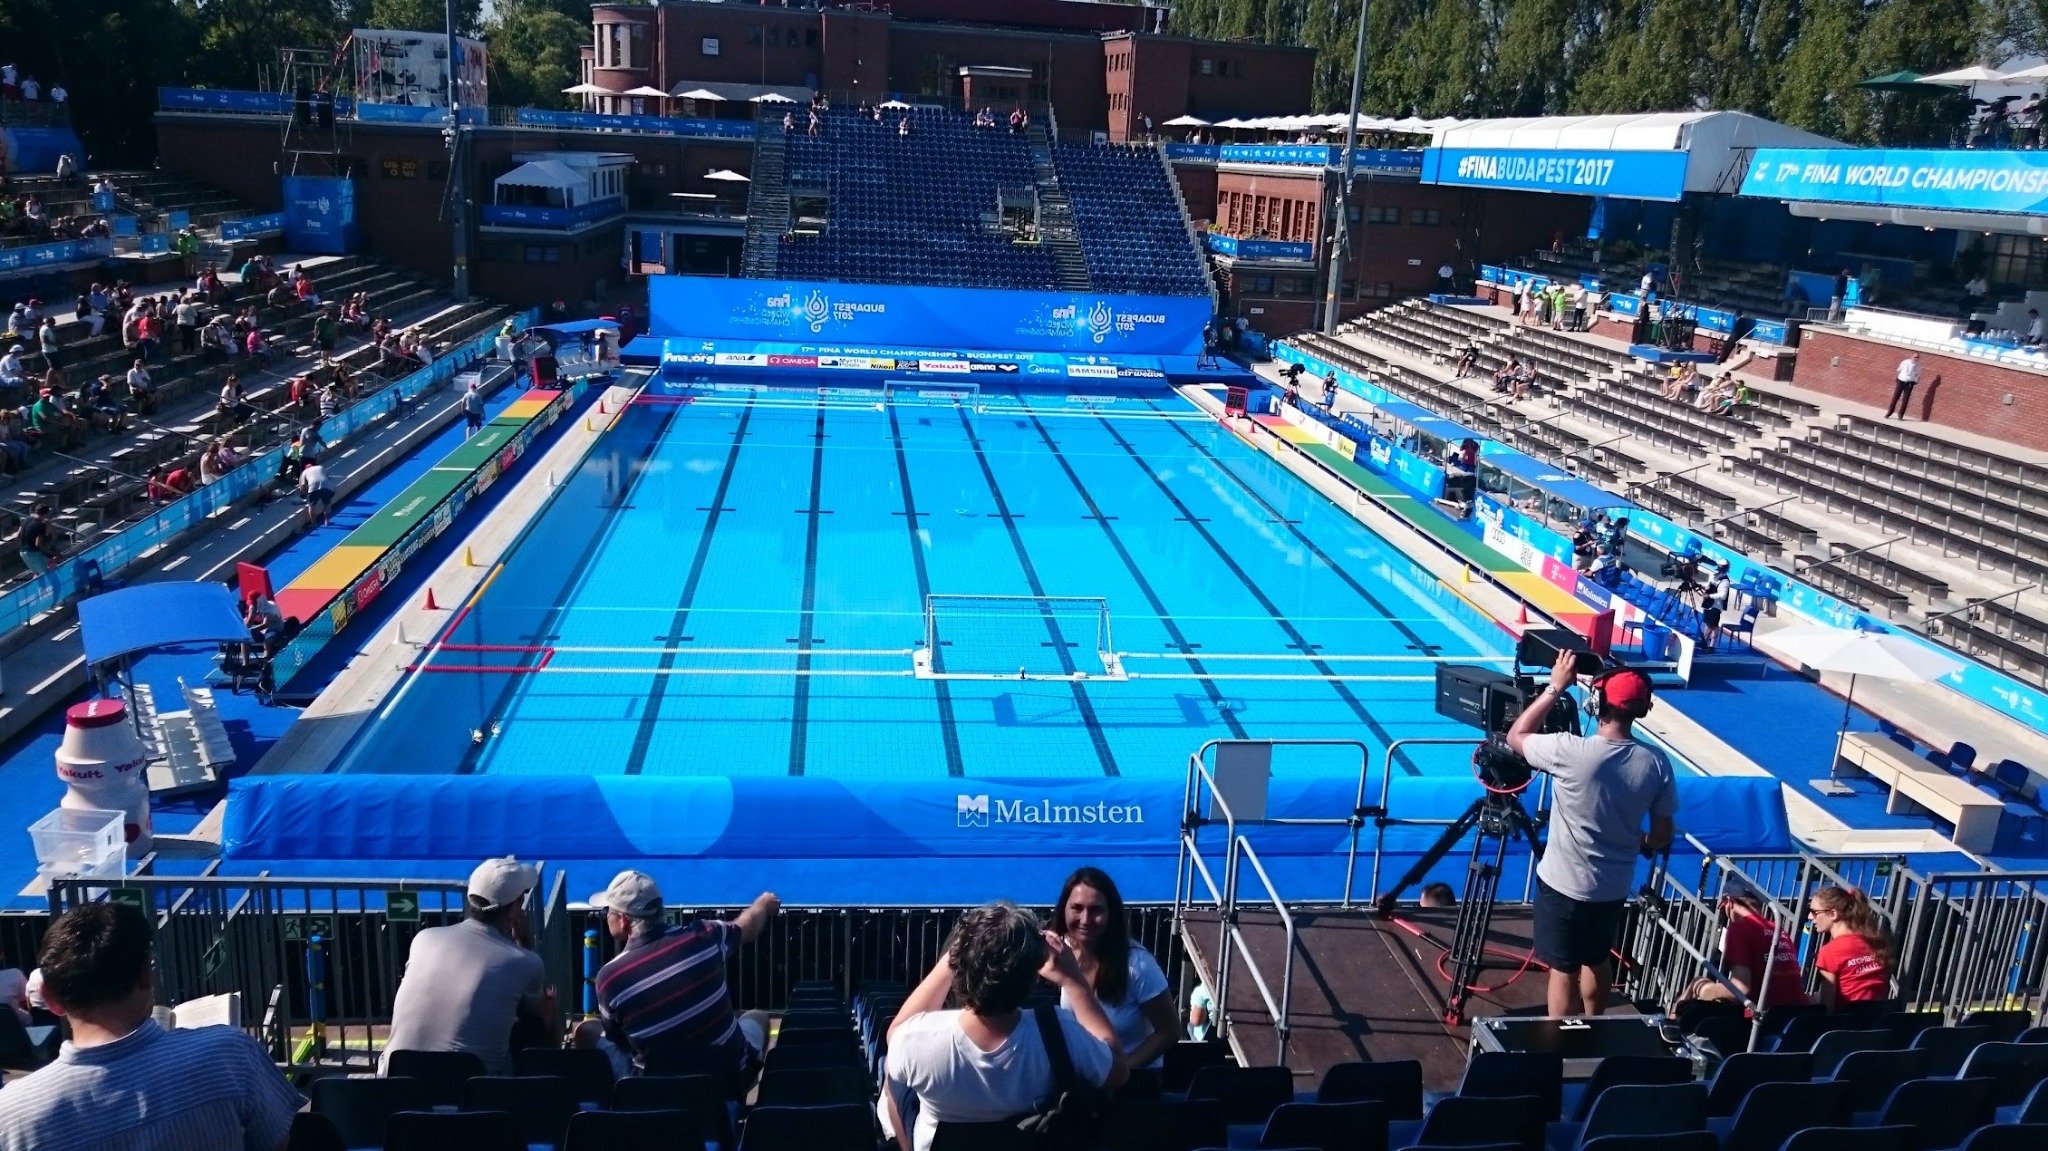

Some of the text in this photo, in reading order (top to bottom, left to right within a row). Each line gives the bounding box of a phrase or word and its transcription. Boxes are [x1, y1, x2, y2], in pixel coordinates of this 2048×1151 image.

[1457, 154, 1615, 187] #FINABUDAPEST2017
[1775, 162, 1799, 183] 17th
[1801, 163, 1840, 185] FINA
[1844, 164, 1909, 189] WORLD
[782, 357, 817, 365] OMEGA
[818, 346, 841, 354] FINA
[843, 347, 878, 355] WORLD
[879, 349, 958, 359] CHAMPIONSHIPS
[966, 352, 1014, 360] BUDAPEST
[1014, 353, 1035, 362] 2017
[870, 362, 895, 370] Nikon
[923, 361, 968, 371] Yakult
[1068, 367, 1117, 376] SAMSUNG
[1581, 586, 1608, 609] Malmsten
[113, 752, 145, 774] Yakul
[57, 766, 104, 779] Yakult
[994, 798, 1145, 824] Malmsten
